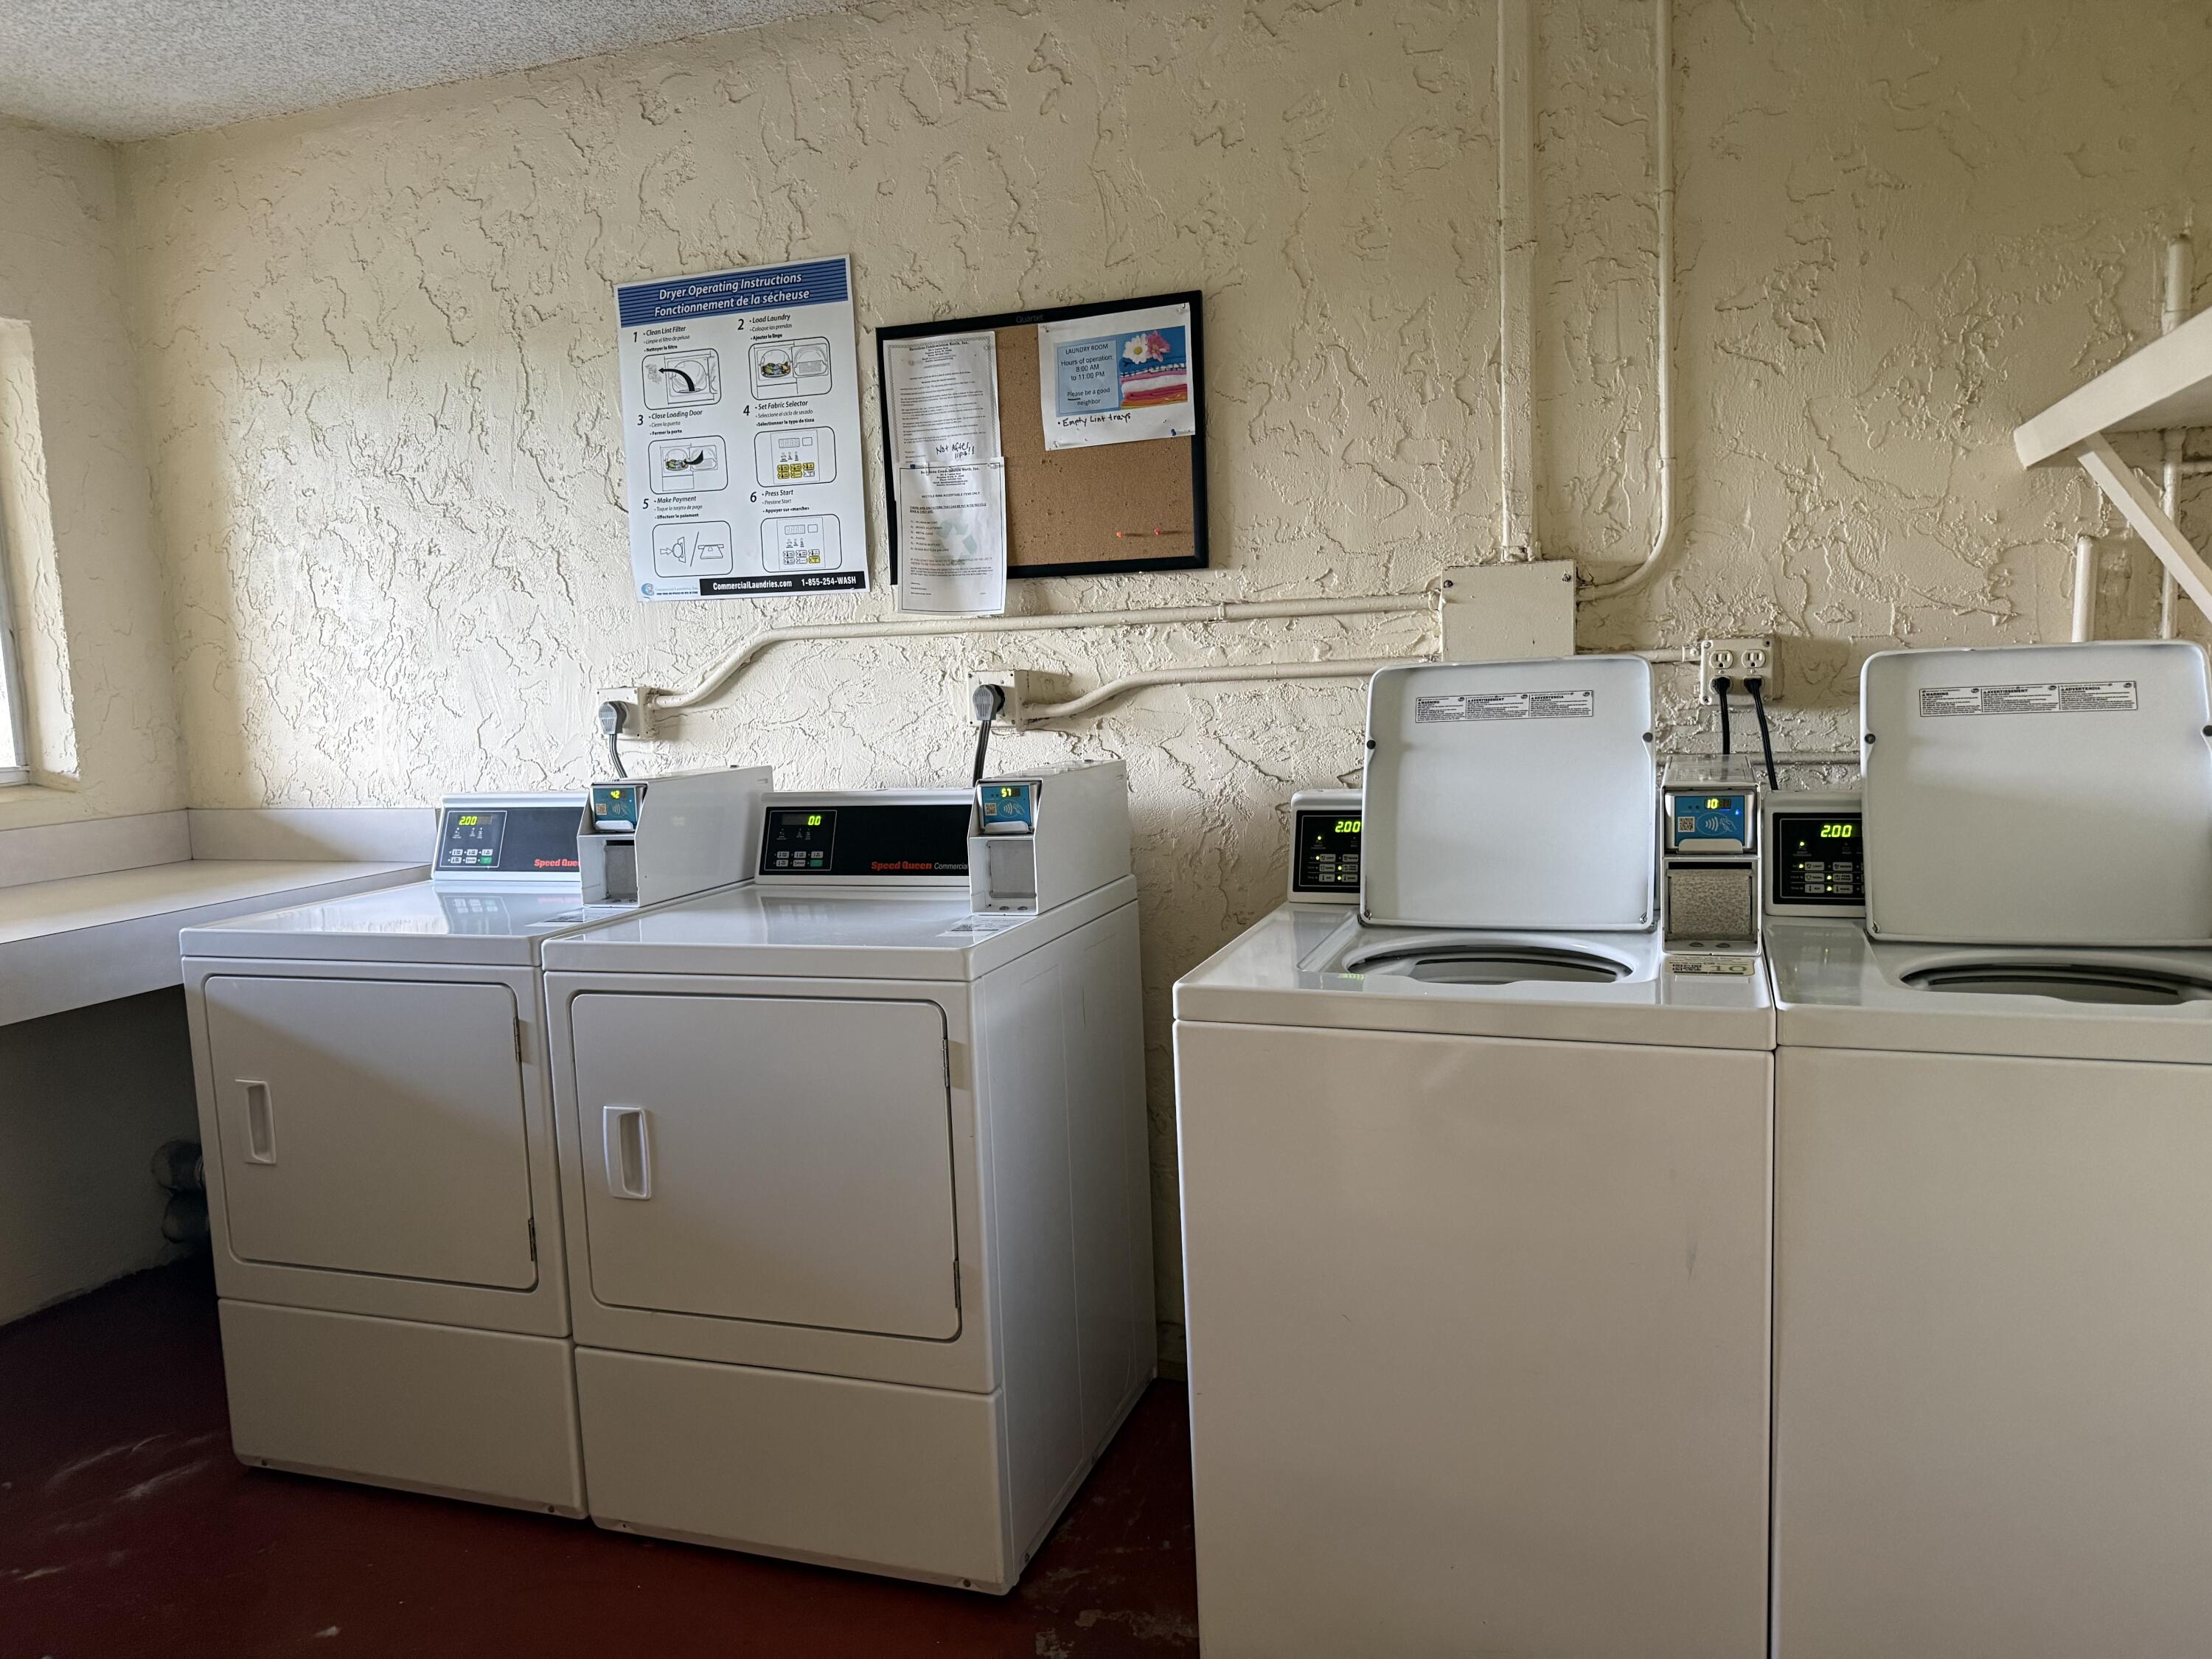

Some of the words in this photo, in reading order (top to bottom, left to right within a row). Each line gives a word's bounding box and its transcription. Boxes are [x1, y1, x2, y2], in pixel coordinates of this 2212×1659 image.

[659, 288, 686, 300] Dryer
[688, 282, 738, 297] Operating
[740, 274, 802, 289] Instructions
[654, 299, 734, 317] Fonctionnement
[737, 296, 748, 307] de
[751, 294, 760, 305] la
[762, 290, 810, 303] sécheuse
[752, 316, 766, 324] Load
[767, 313, 790, 321] Laundry
[737, 319, 744, 330] 2
[633, 331, 638, 343] 1
[646, 328, 661, 336] Clean
[1065, 346, 1090, 355] LAUNDRY
[1085, 355, 1113, 364] operation:
[1096, 387, 1110, 395] good
[743, 405, 750, 417] 4
[637, 414, 644, 425] 3
[1062, 417, 1087, 427] Empty
[1107, 412, 1131, 423] trays
[936, 445, 948, 455] Not
[672, 495, 697, 504] Payment
[750, 491, 757, 503] 6
[642, 498, 650, 509] 5
[712, 579, 793, 591] CommercialLaundries.com
[801, 576, 857, 586] 1-855-254-WASH
[1707, 798, 1719, 810] 10
[459, 815, 478, 826] 2.00
[807, 815, 821, 826] 00
[1335, 821, 1361, 832] 2.00
[1820, 824, 1852, 838] 2.00
[534, 858, 561, 868] Speed
[561, 858, 579, 866] Que
[872, 861, 901, 871] Speed
[902, 861, 933, 869] Queen
